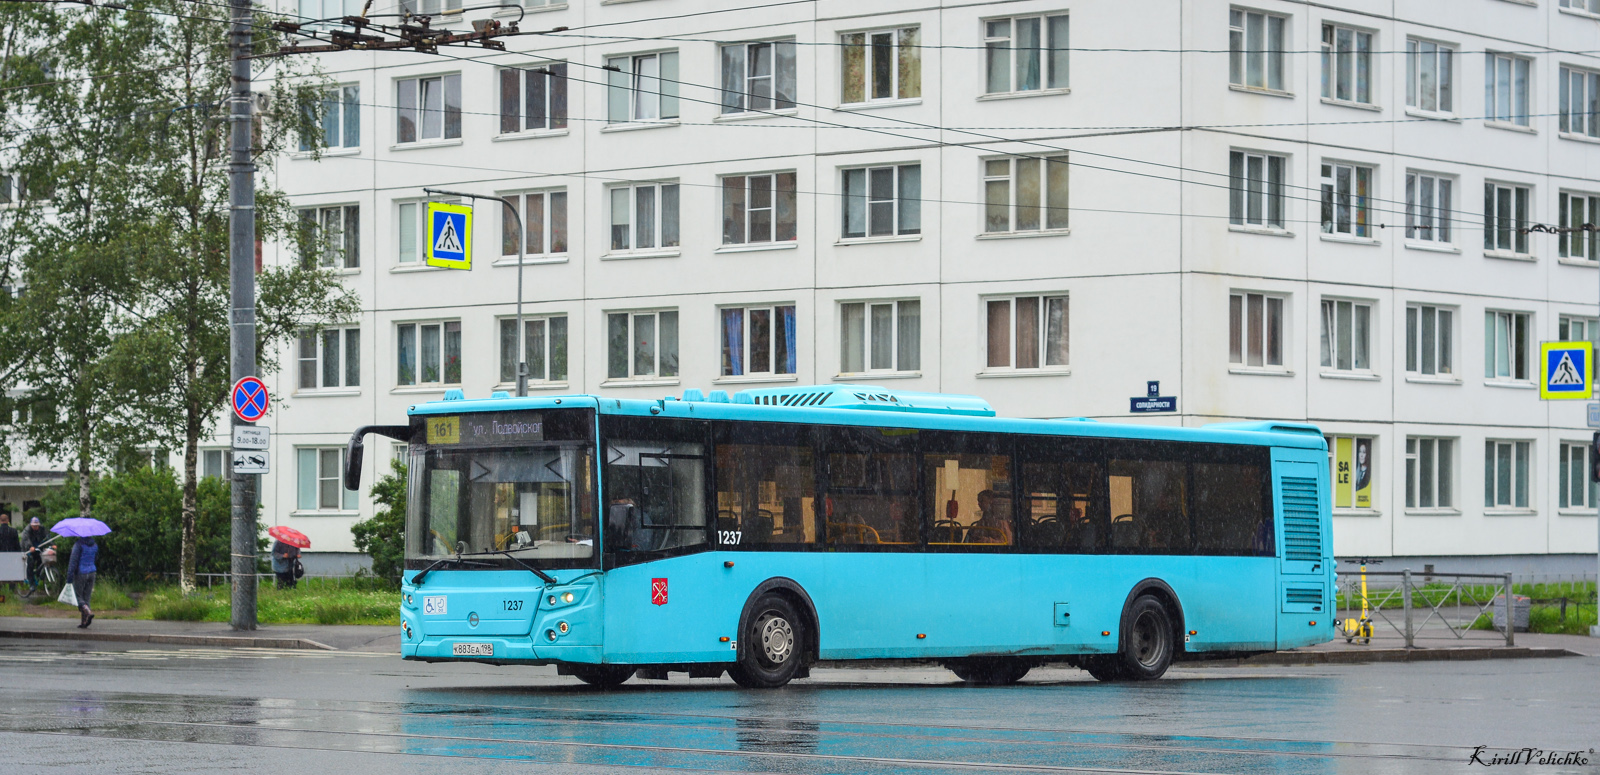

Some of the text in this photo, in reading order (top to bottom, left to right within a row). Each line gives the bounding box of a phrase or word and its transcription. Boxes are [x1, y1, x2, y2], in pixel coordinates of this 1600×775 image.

[1150, 384, 1157, 392] 19
[1136, 401, 1170, 409] СОЛИДАРНОСТИ
[434, 423, 452, 437] 161
[1338, 461, 1349, 472] SA
[1338, 473, 1349, 484] LE
[717, 530, 742, 545] 1237
[503, 600, 524, 611] 1237
